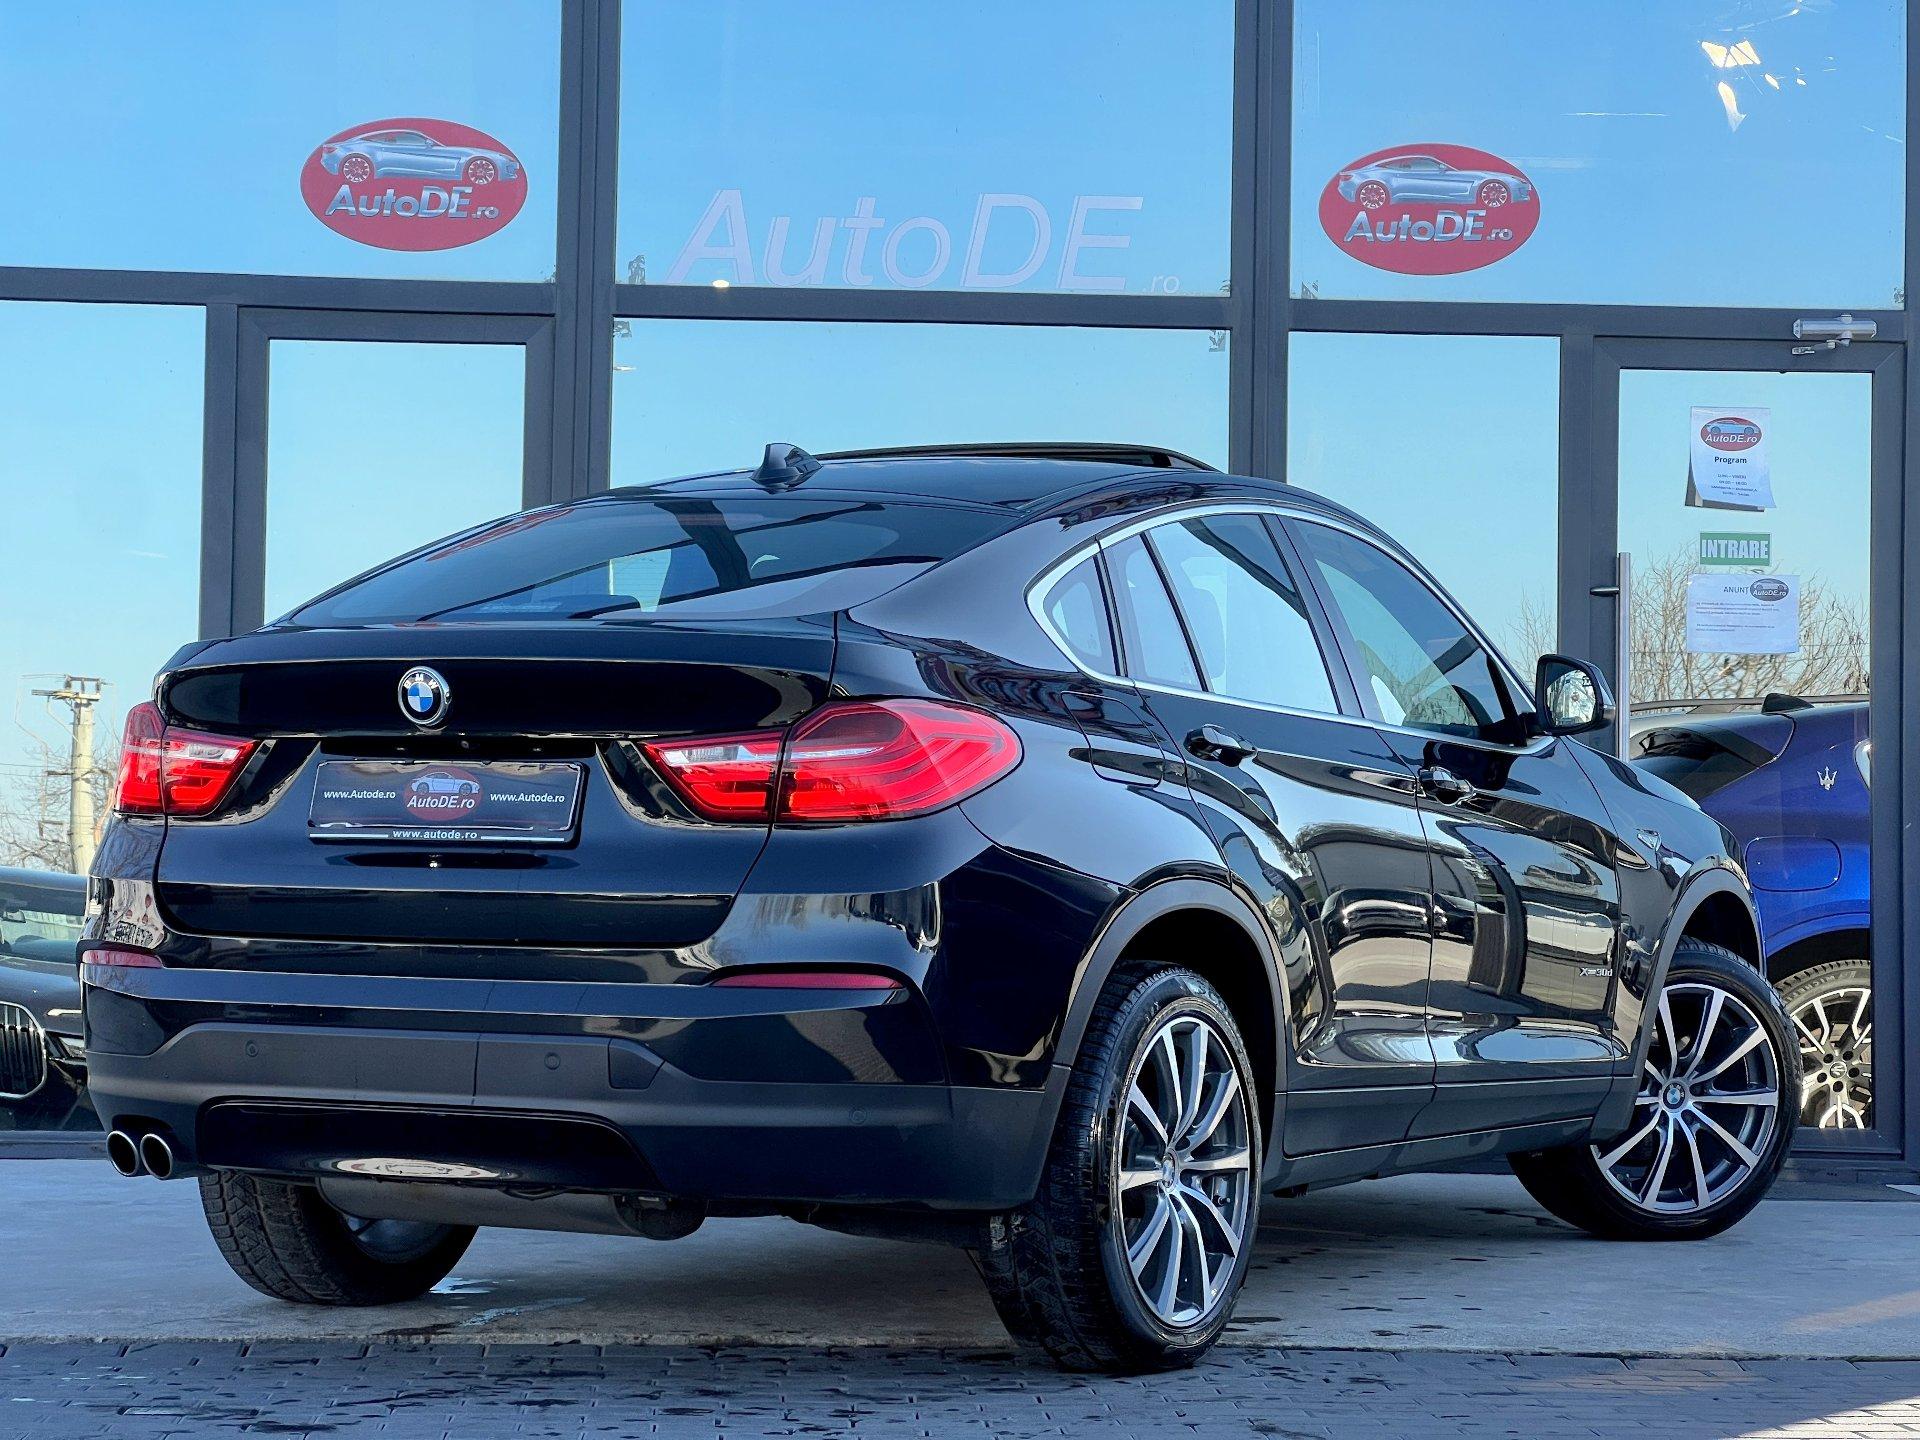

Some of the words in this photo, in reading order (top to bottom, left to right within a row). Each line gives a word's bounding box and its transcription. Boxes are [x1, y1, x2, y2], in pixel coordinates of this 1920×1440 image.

[1705, 434, 1758, 443] AutoDE.ro
[1714, 456, 1747, 465] Program
[1701, 539, 1769, 559] INTRARE
[403, 673, 439, 689] BMW
[324, 789, 396, 800] www.Autode.ro
[490, 793, 566, 804] www.Autode.ro
[406, 795, 476, 810] AutoDE.ro
[392, 829, 478, 841] www.autode.ro
